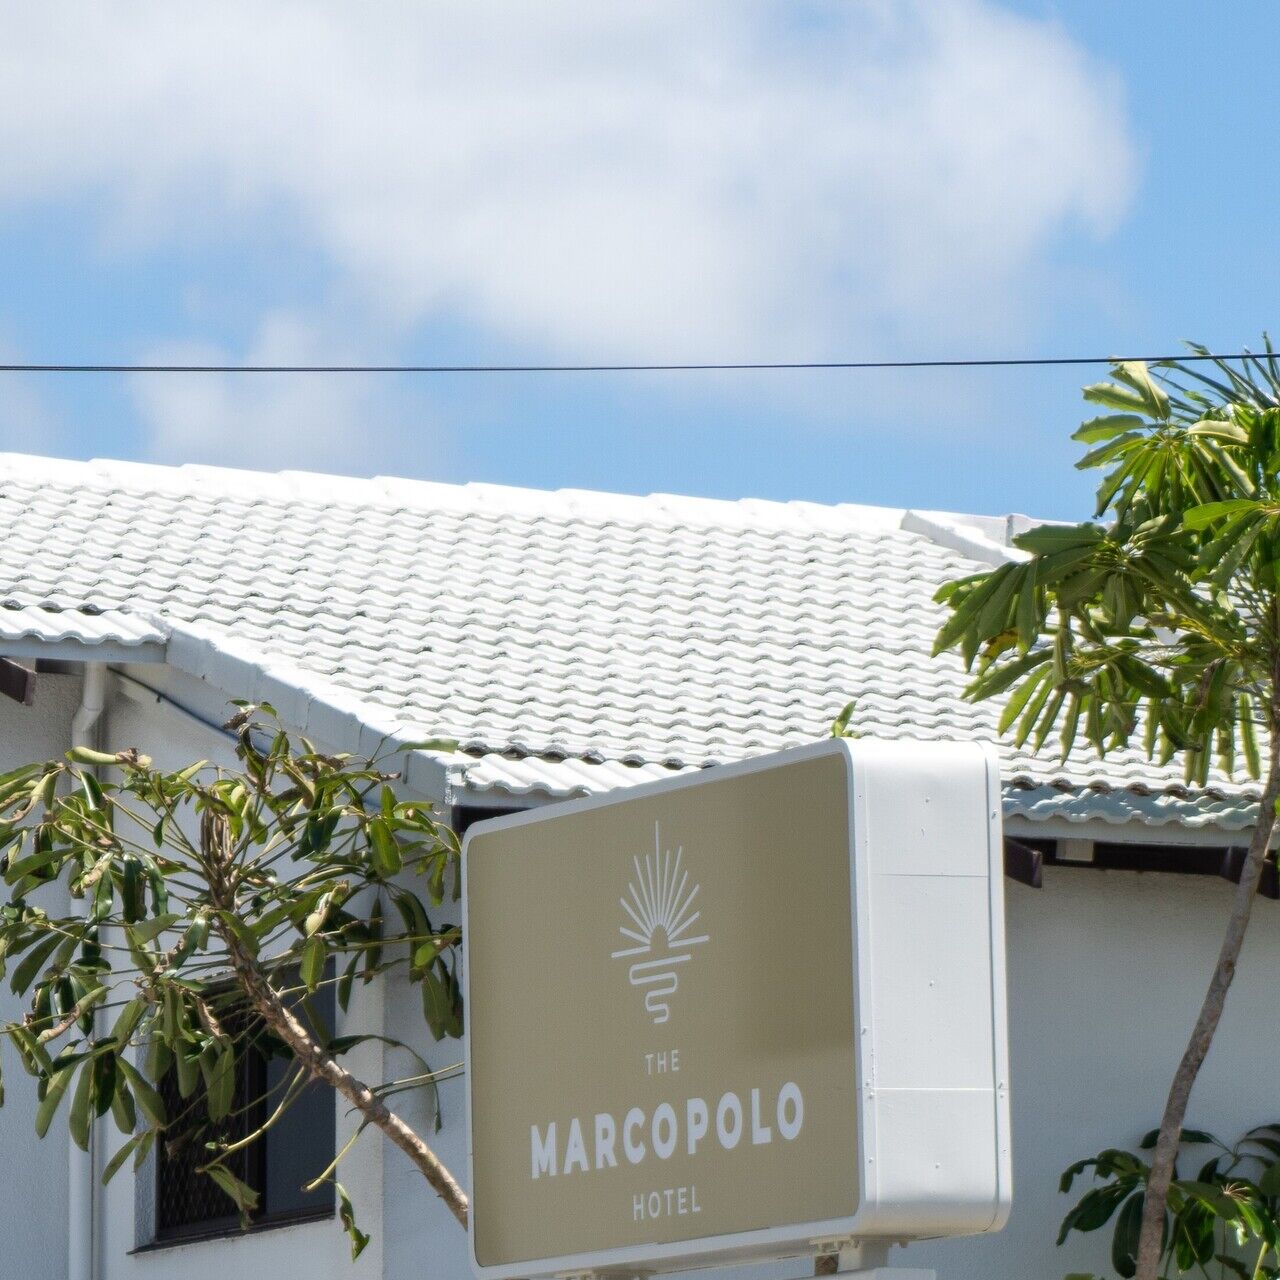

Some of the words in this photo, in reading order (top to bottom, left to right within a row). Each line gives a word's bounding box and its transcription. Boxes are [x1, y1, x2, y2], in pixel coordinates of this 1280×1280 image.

[645, 1049, 680, 1075] THE
[531, 1081, 804, 1179] MARCOPOLO
[633, 1185, 701, 1221] HOTEL
